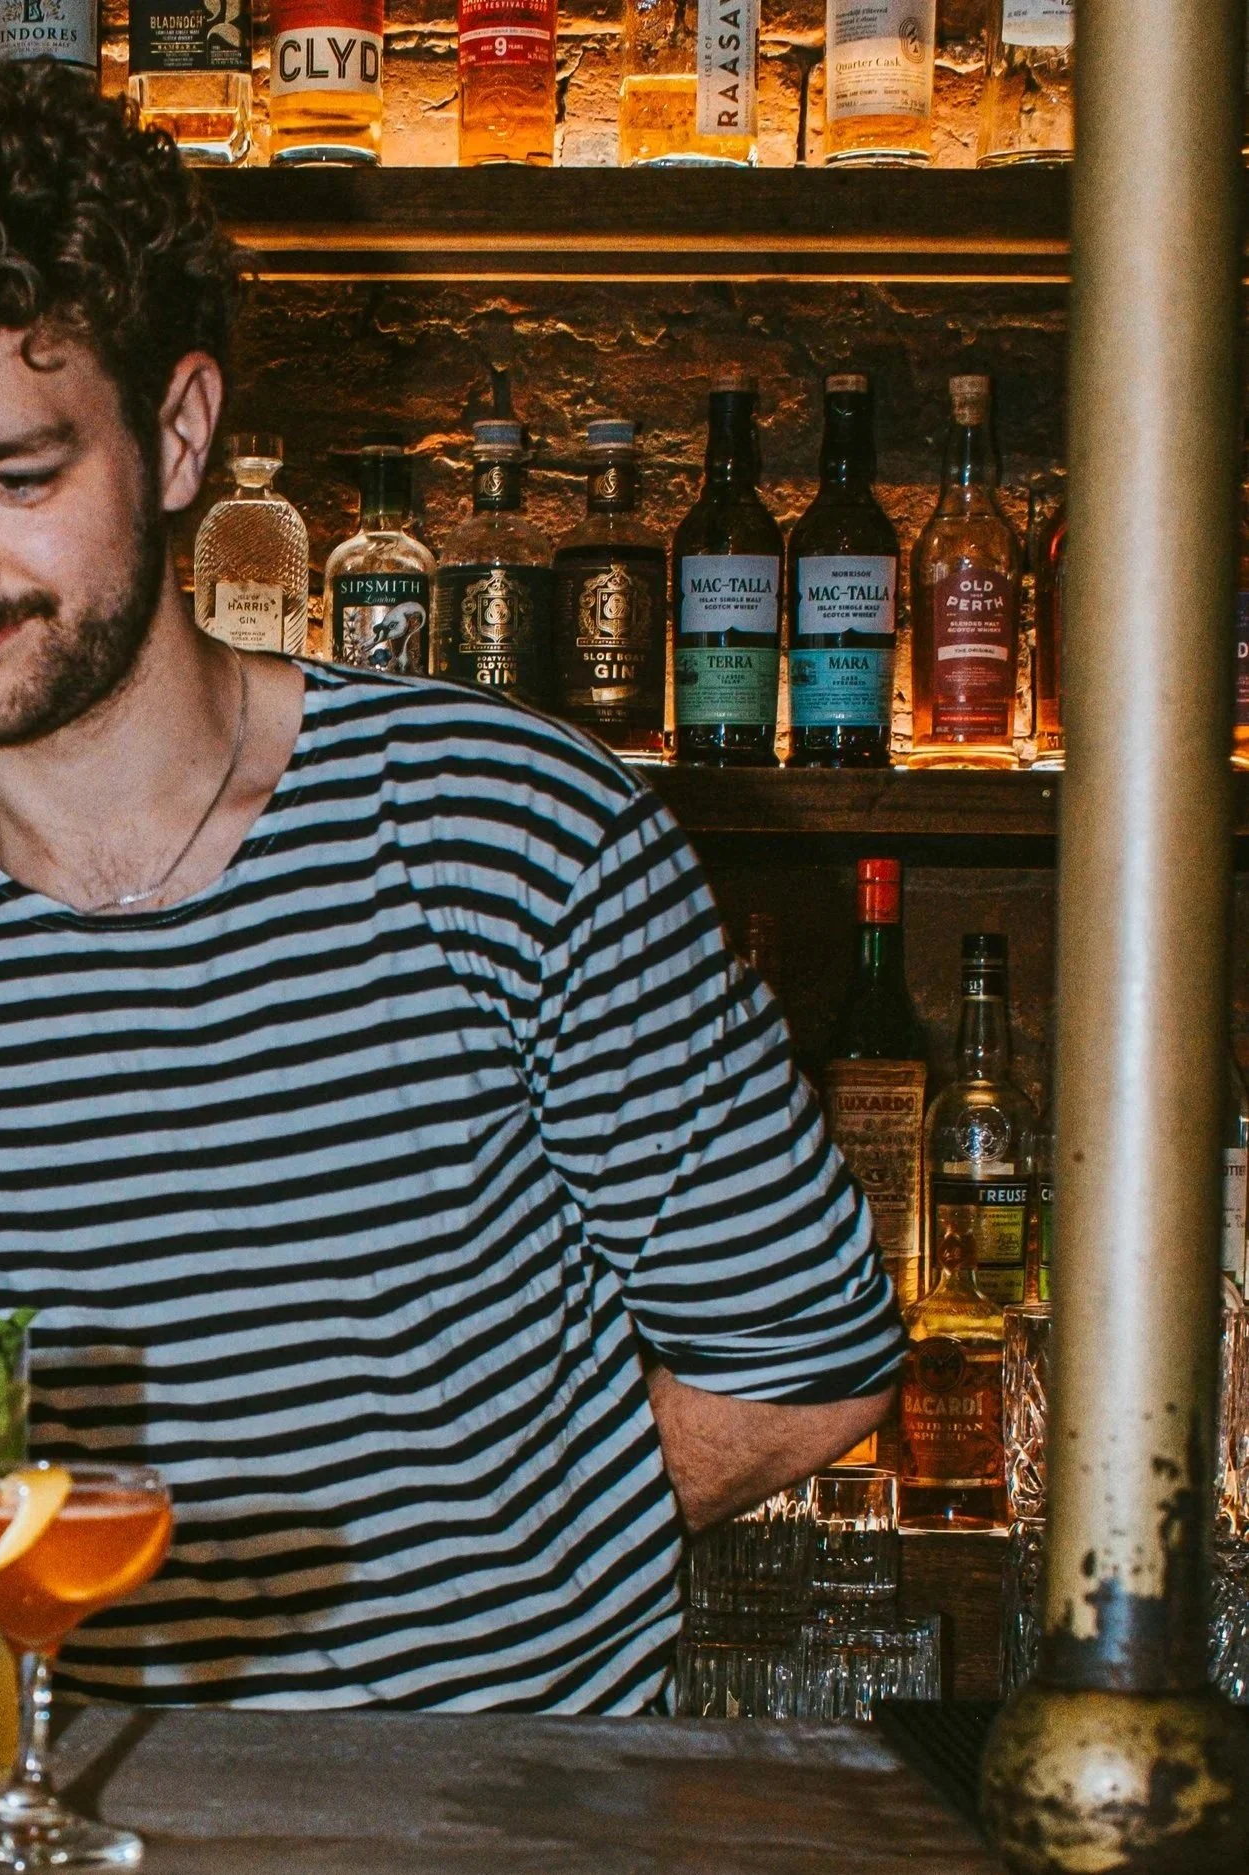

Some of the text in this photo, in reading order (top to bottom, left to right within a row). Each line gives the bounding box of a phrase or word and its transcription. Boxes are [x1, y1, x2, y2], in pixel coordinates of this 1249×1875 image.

[150, 15, 203, 29] BLADNOCH
[494, 37, 507, 57] 9
[279, 37, 379, 83] CLYD
[835, 57, 901, 75] Quarter Cask
[831, 570, 872, 578] MORRISON
[340, 579, 421, 595] SIPSMITH
[690, 577, 773, 594] MAC-TALLA
[959, 580, 994, 592] OLD
[364, 595, 397, 604] London
[808, 585, 890, 601] MAC-TALLA
[227, 601, 270, 612] HARRIS
[946, 595, 1004, 611] PERTH
[239, 616, 256, 625] GIN
[583, 652, 613, 661] SLOE
[707, 655, 753, 669] TERRA
[829, 656, 870, 670] MARA
[476, 669, 517, 684] GIN
[594, 663, 635, 679] GIN
